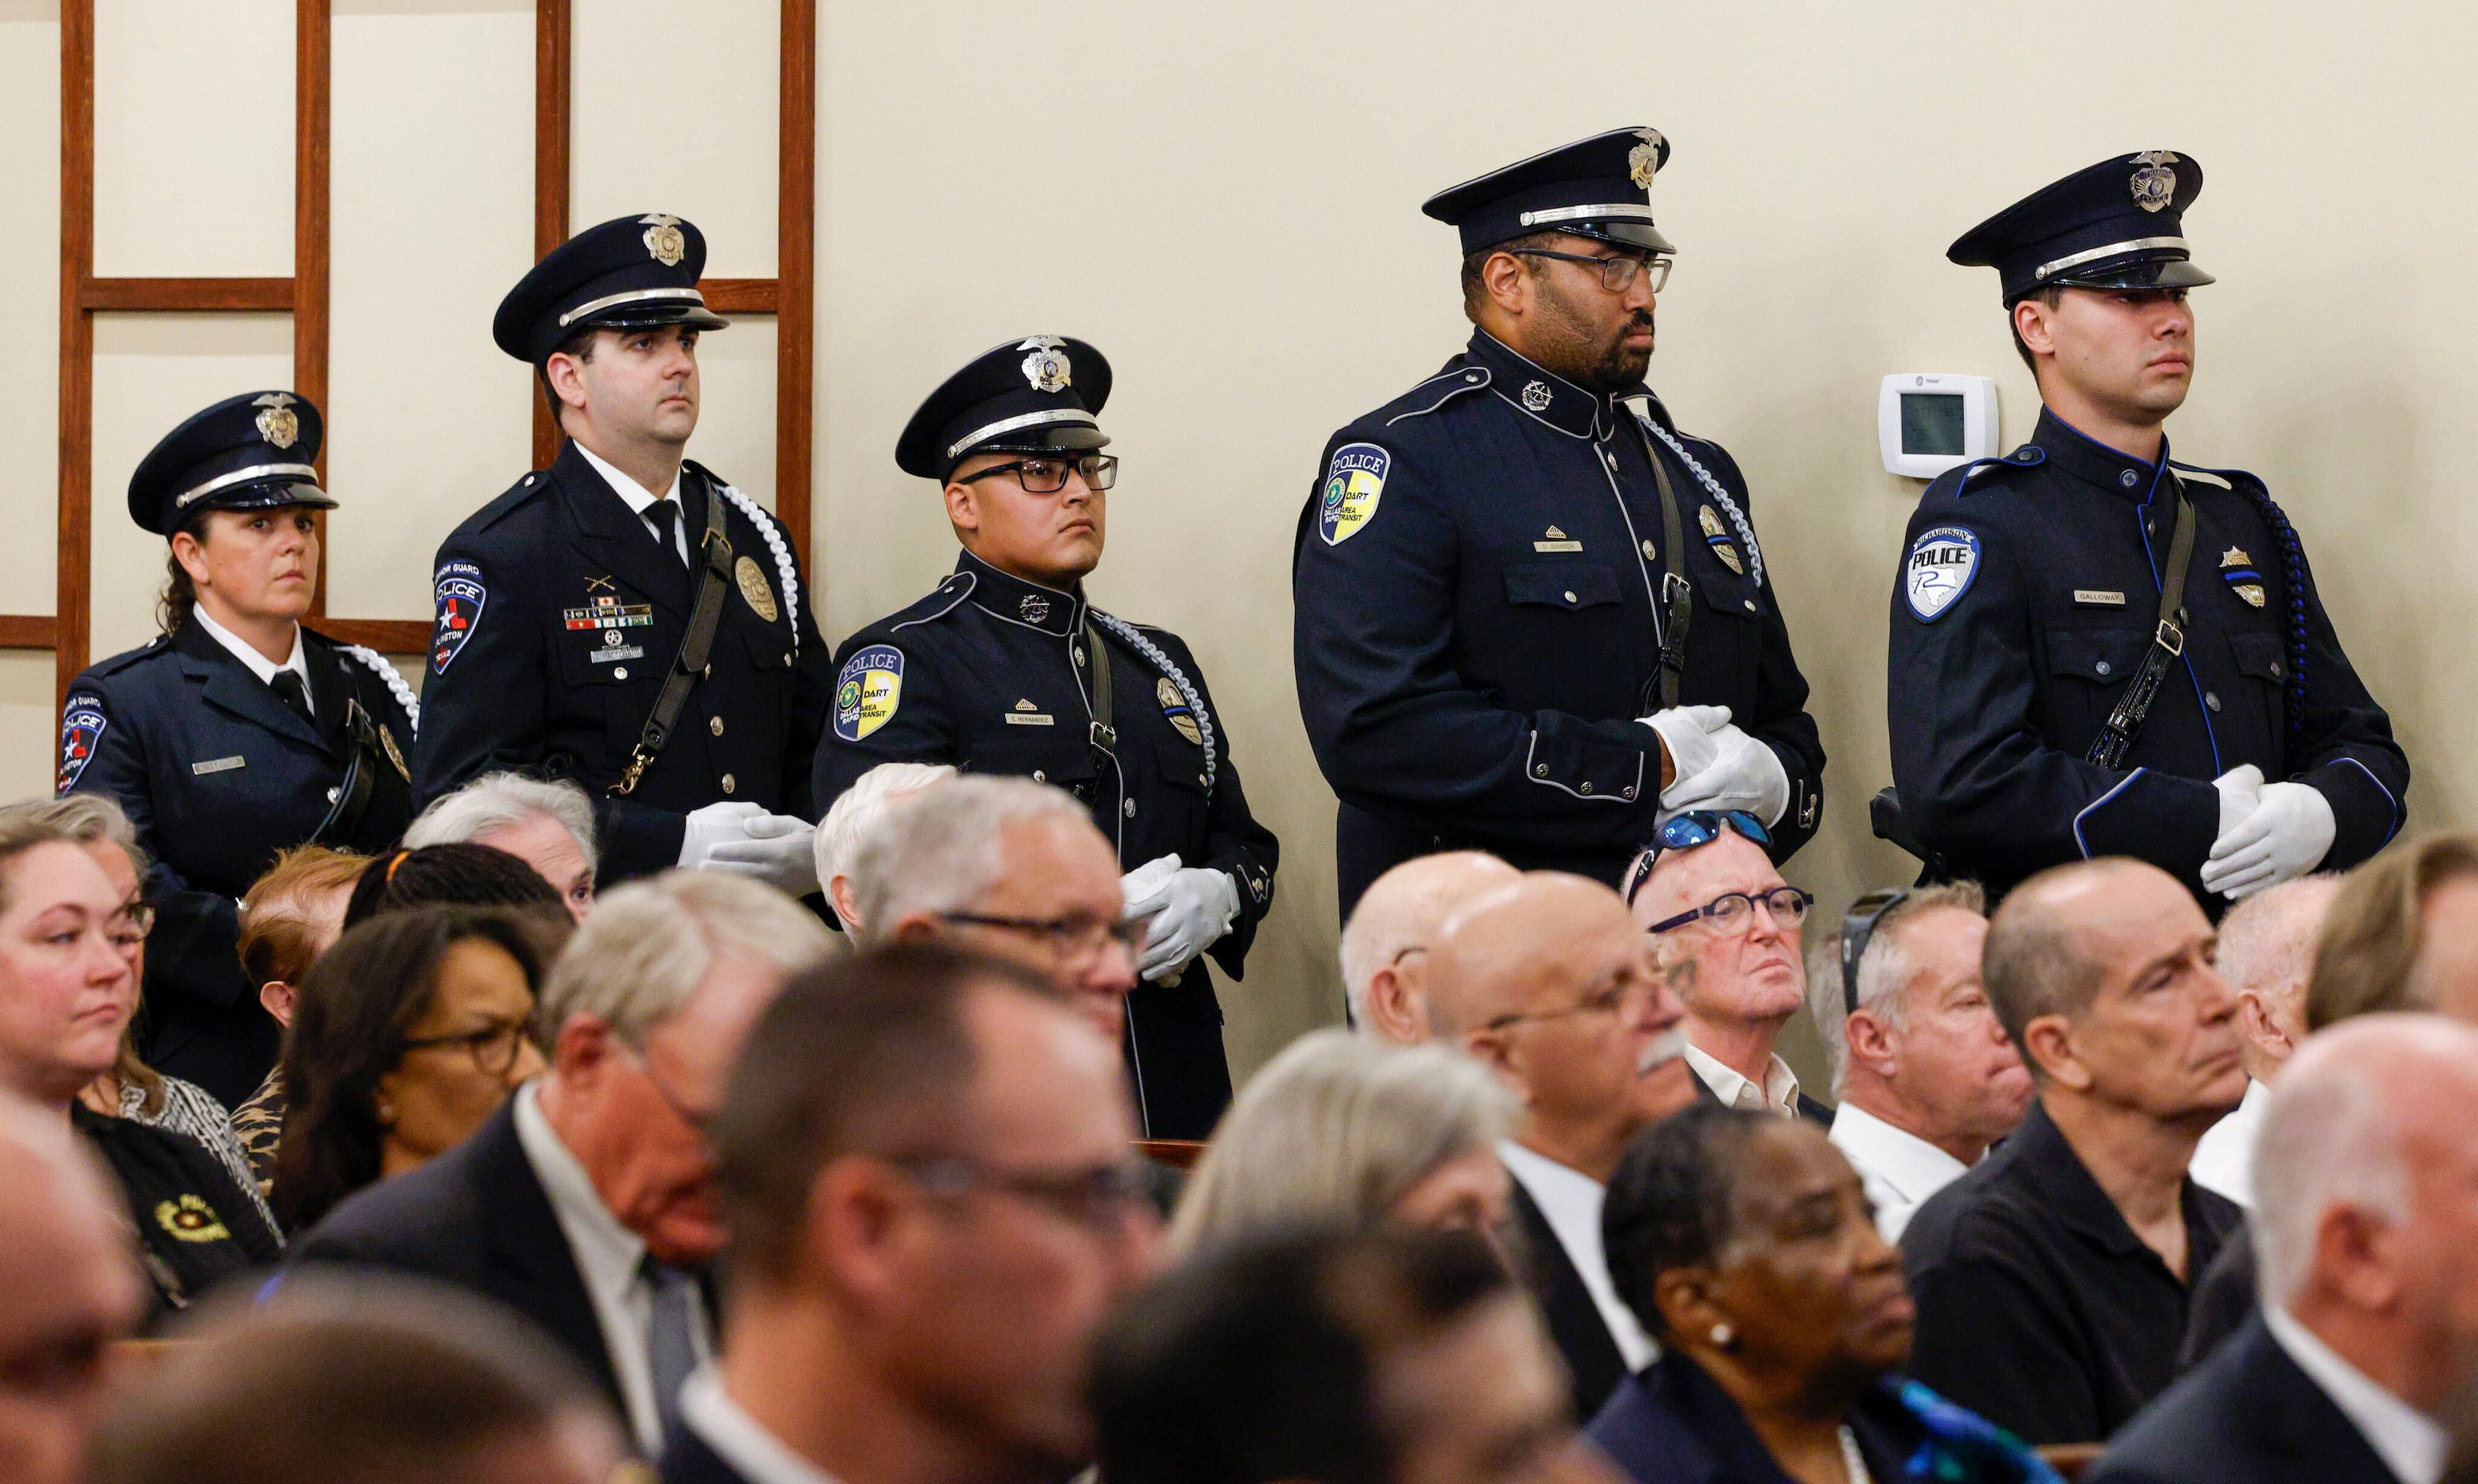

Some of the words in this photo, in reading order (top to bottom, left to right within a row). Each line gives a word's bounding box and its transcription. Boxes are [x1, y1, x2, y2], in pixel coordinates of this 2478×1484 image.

[1332, 454, 1384, 474] POLICE
[1346, 492, 1369, 500] DART
[1324, 507, 1342, 517] DALLAS
[1917, 528, 1968, 545] RICHARDSON
[1912, 547, 1968, 570] POLICE
[453, 563, 479, 575] GUARD
[437, 582, 480, 601] OLICE
[843, 653, 897, 680] POLICE
[78, 696, 101, 707] GUARD
[864, 689, 889, 699] DART
[840, 706, 861, 720] DALLAS
[842, 714, 860, 725] RAPID
[860, 710, 886, 719] TRANSIT
[63, 714, 101, 736] OLICE
